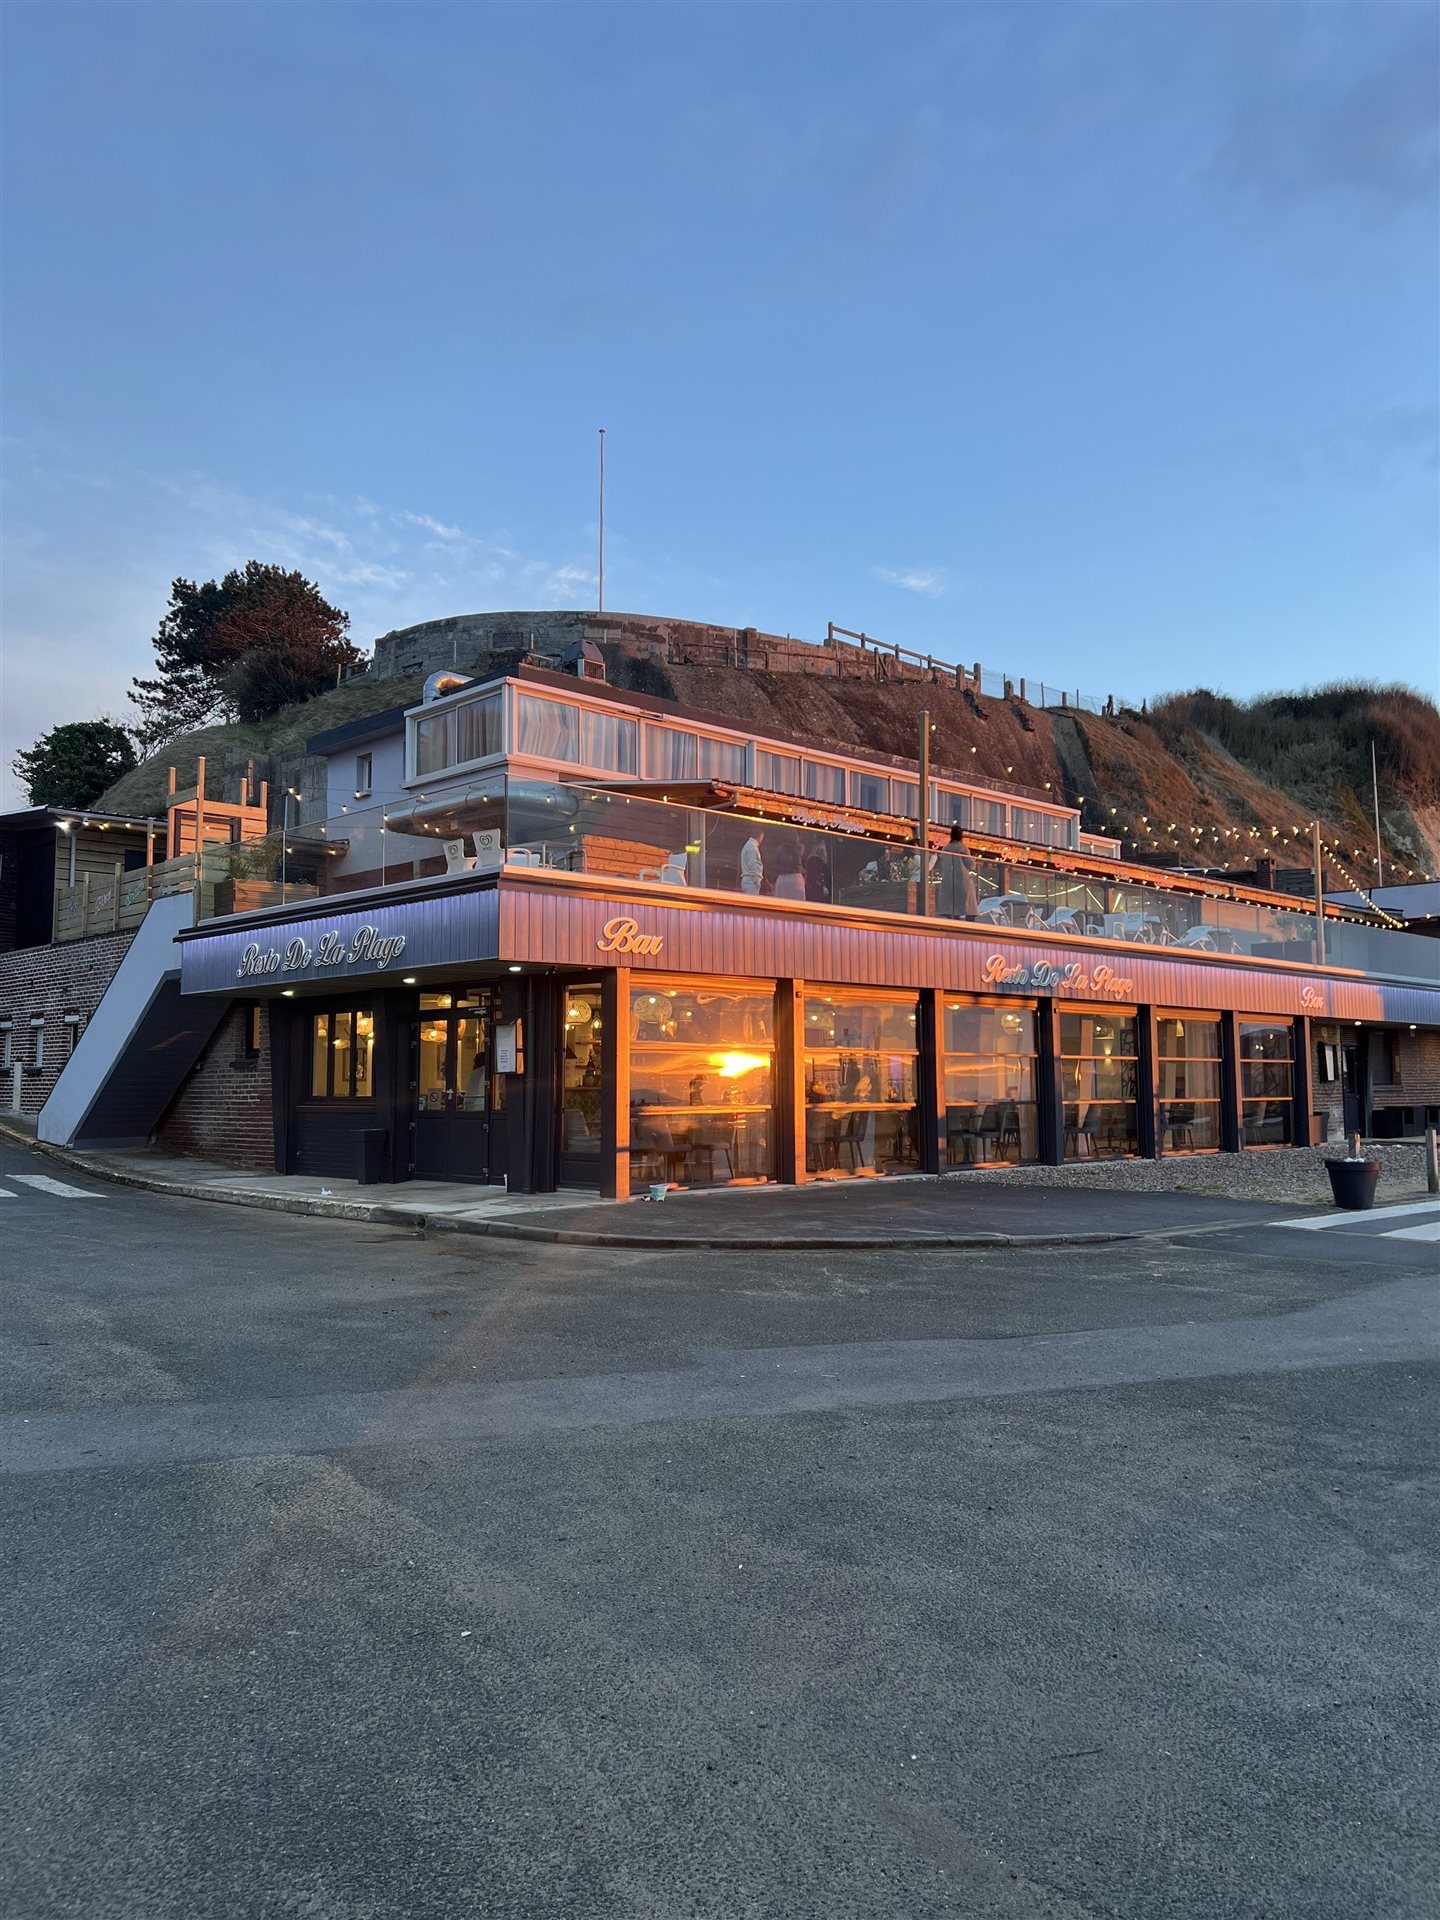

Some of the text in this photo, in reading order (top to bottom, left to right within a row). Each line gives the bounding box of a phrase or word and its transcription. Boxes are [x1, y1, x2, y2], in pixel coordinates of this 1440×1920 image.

[236, 925, 406, 978] Resto De La Plage
[597, 916, 664, 956] Bar
[981, 953, 1134, 1000] Resto De La Plage
[1300, 986, 1324, 1009] Bar
